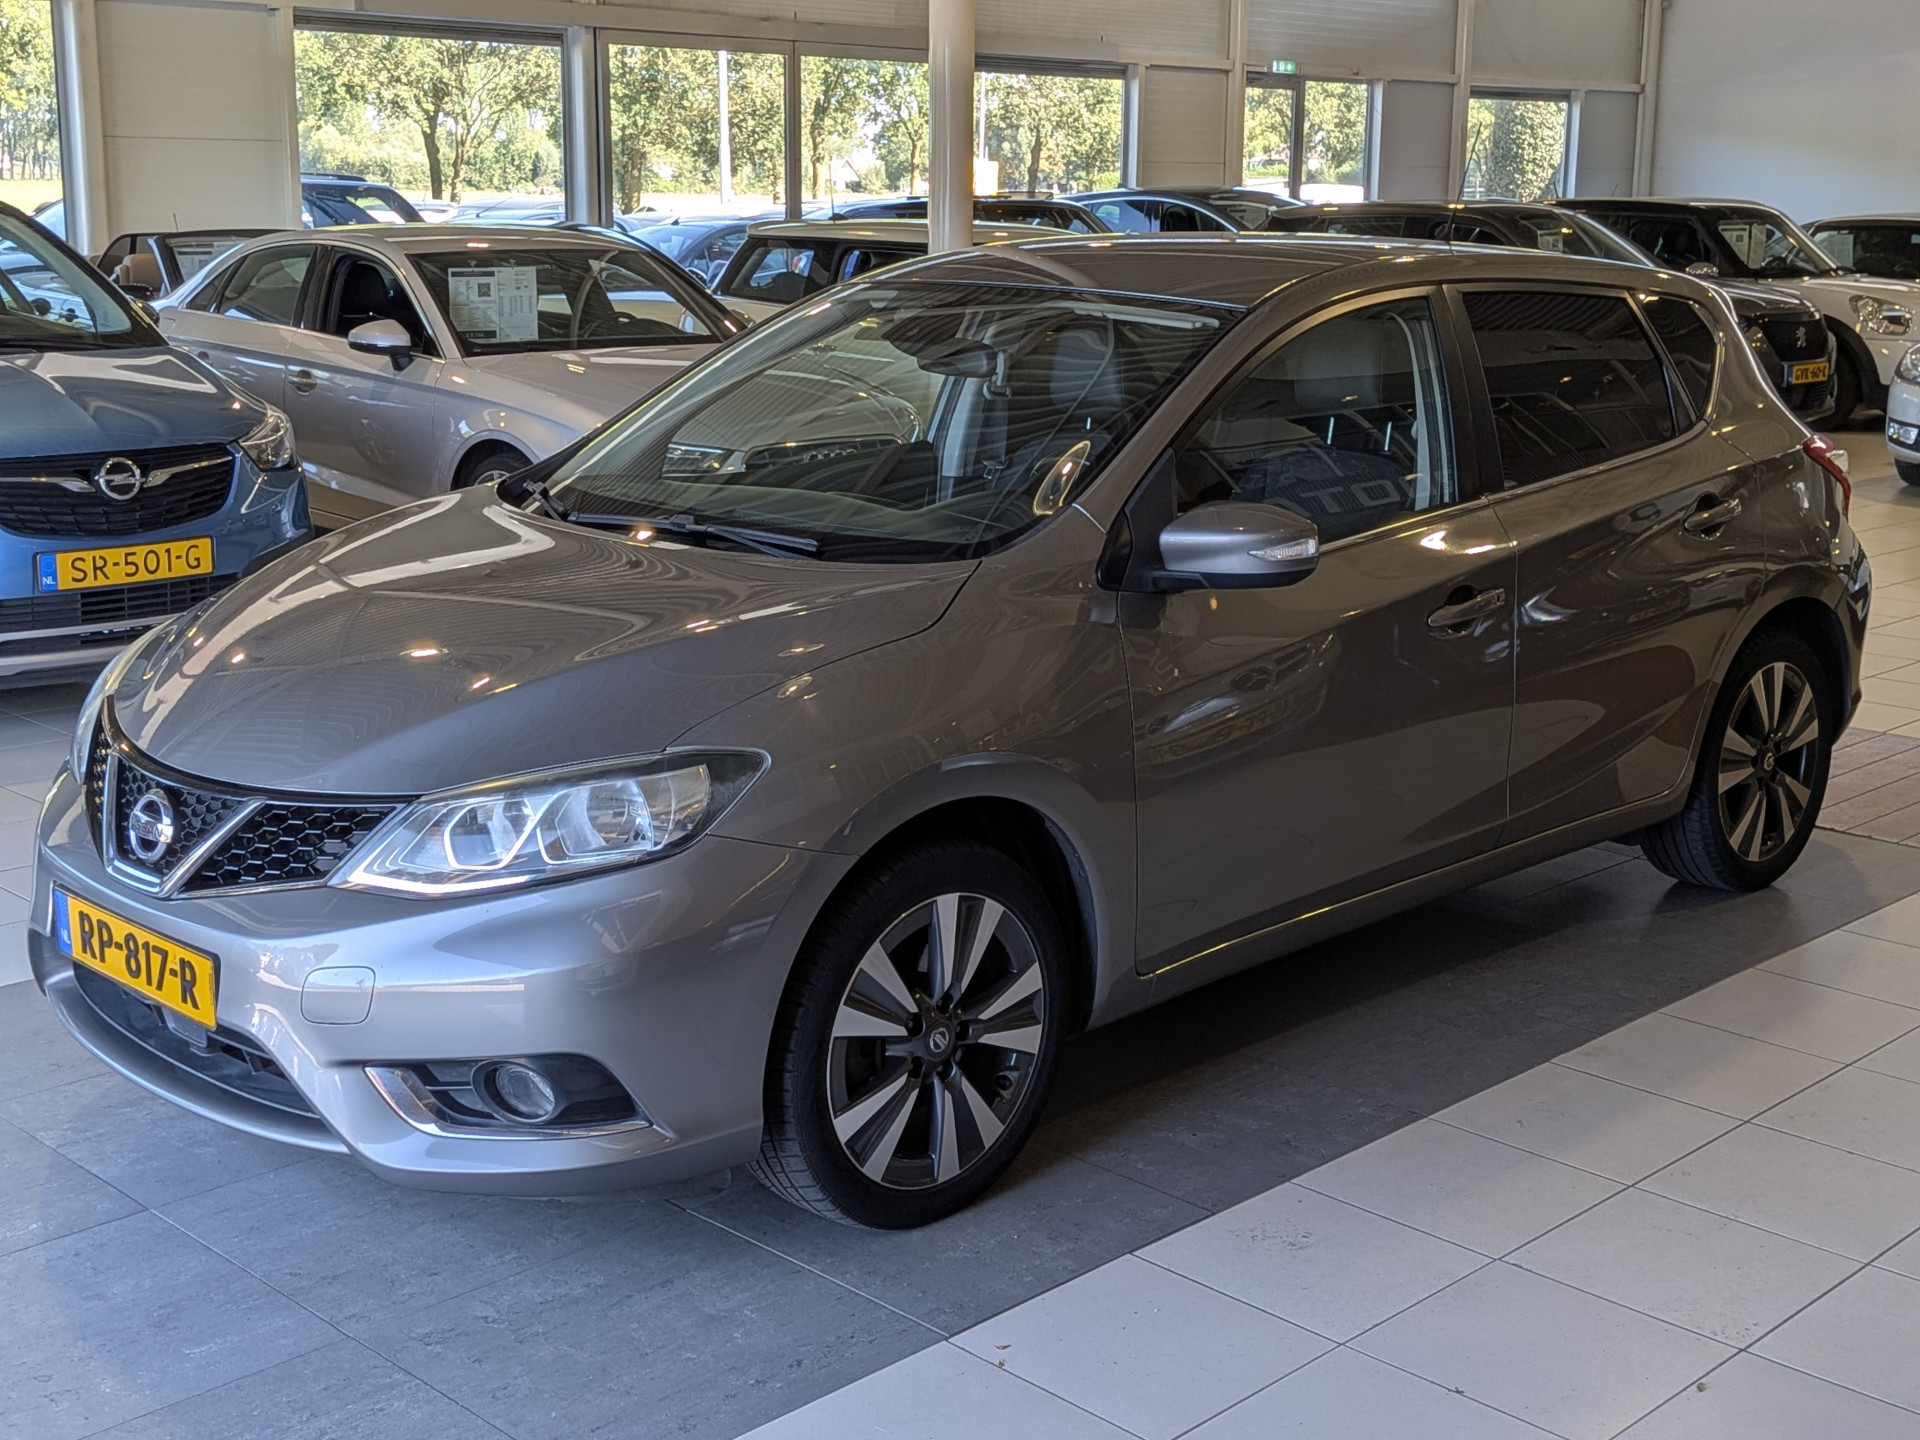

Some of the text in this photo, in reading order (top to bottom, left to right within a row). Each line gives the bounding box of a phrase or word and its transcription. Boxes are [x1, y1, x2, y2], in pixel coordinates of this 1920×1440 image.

[71, 545, 201, 582] SR-501-G
[42, 575, 56, 586] NL
[60, 927, 71, 945] NL
[78, 910, 199, 1010] RP-817-R
